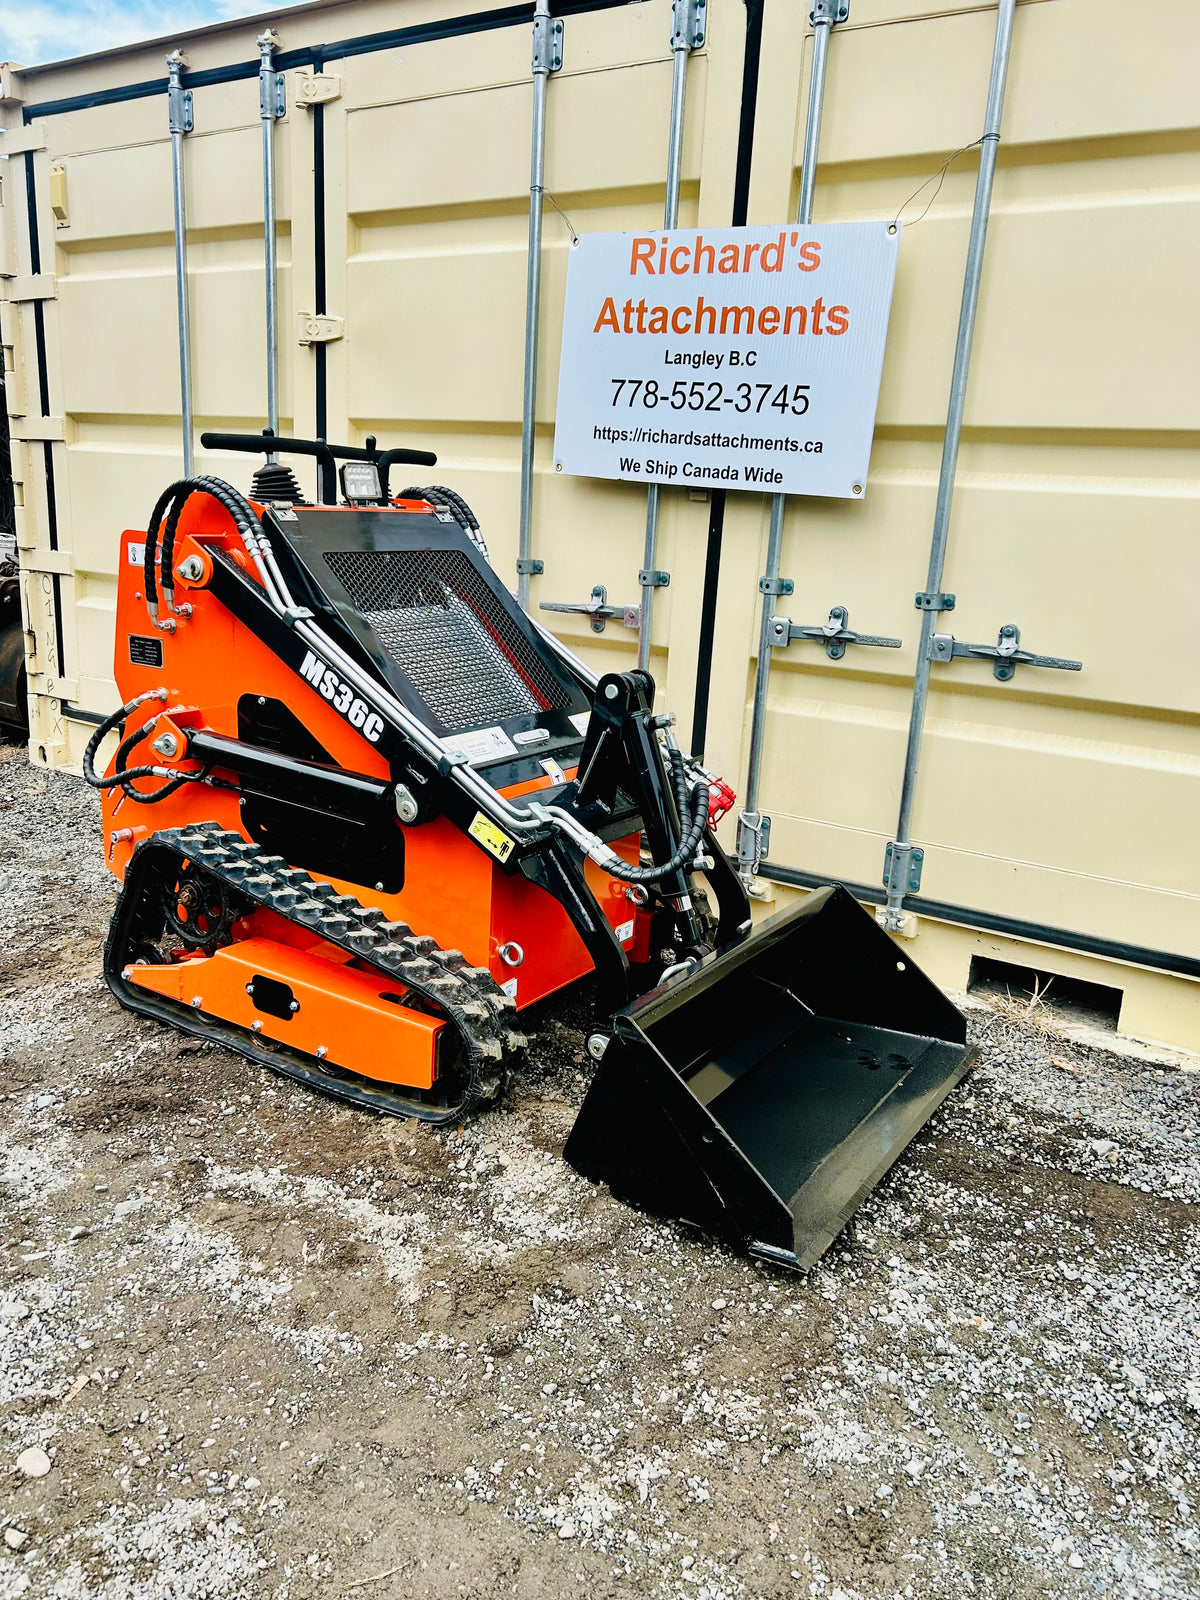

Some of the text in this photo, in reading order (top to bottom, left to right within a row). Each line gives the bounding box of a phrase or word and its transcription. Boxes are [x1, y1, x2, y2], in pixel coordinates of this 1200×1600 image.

[630, 231, 822, 275] Richard's
[593, 296, 850, 336] Attachments
[664, 349, 758, 370] Langley B.C
[611, 379, 811, 416] 778-552-3745
[593, 425, 824, 454] https://richardsattachments.ca
[619, 457, 784, 484] We Ship Canada Wide
[299, 650, 385, 742] MS36C
